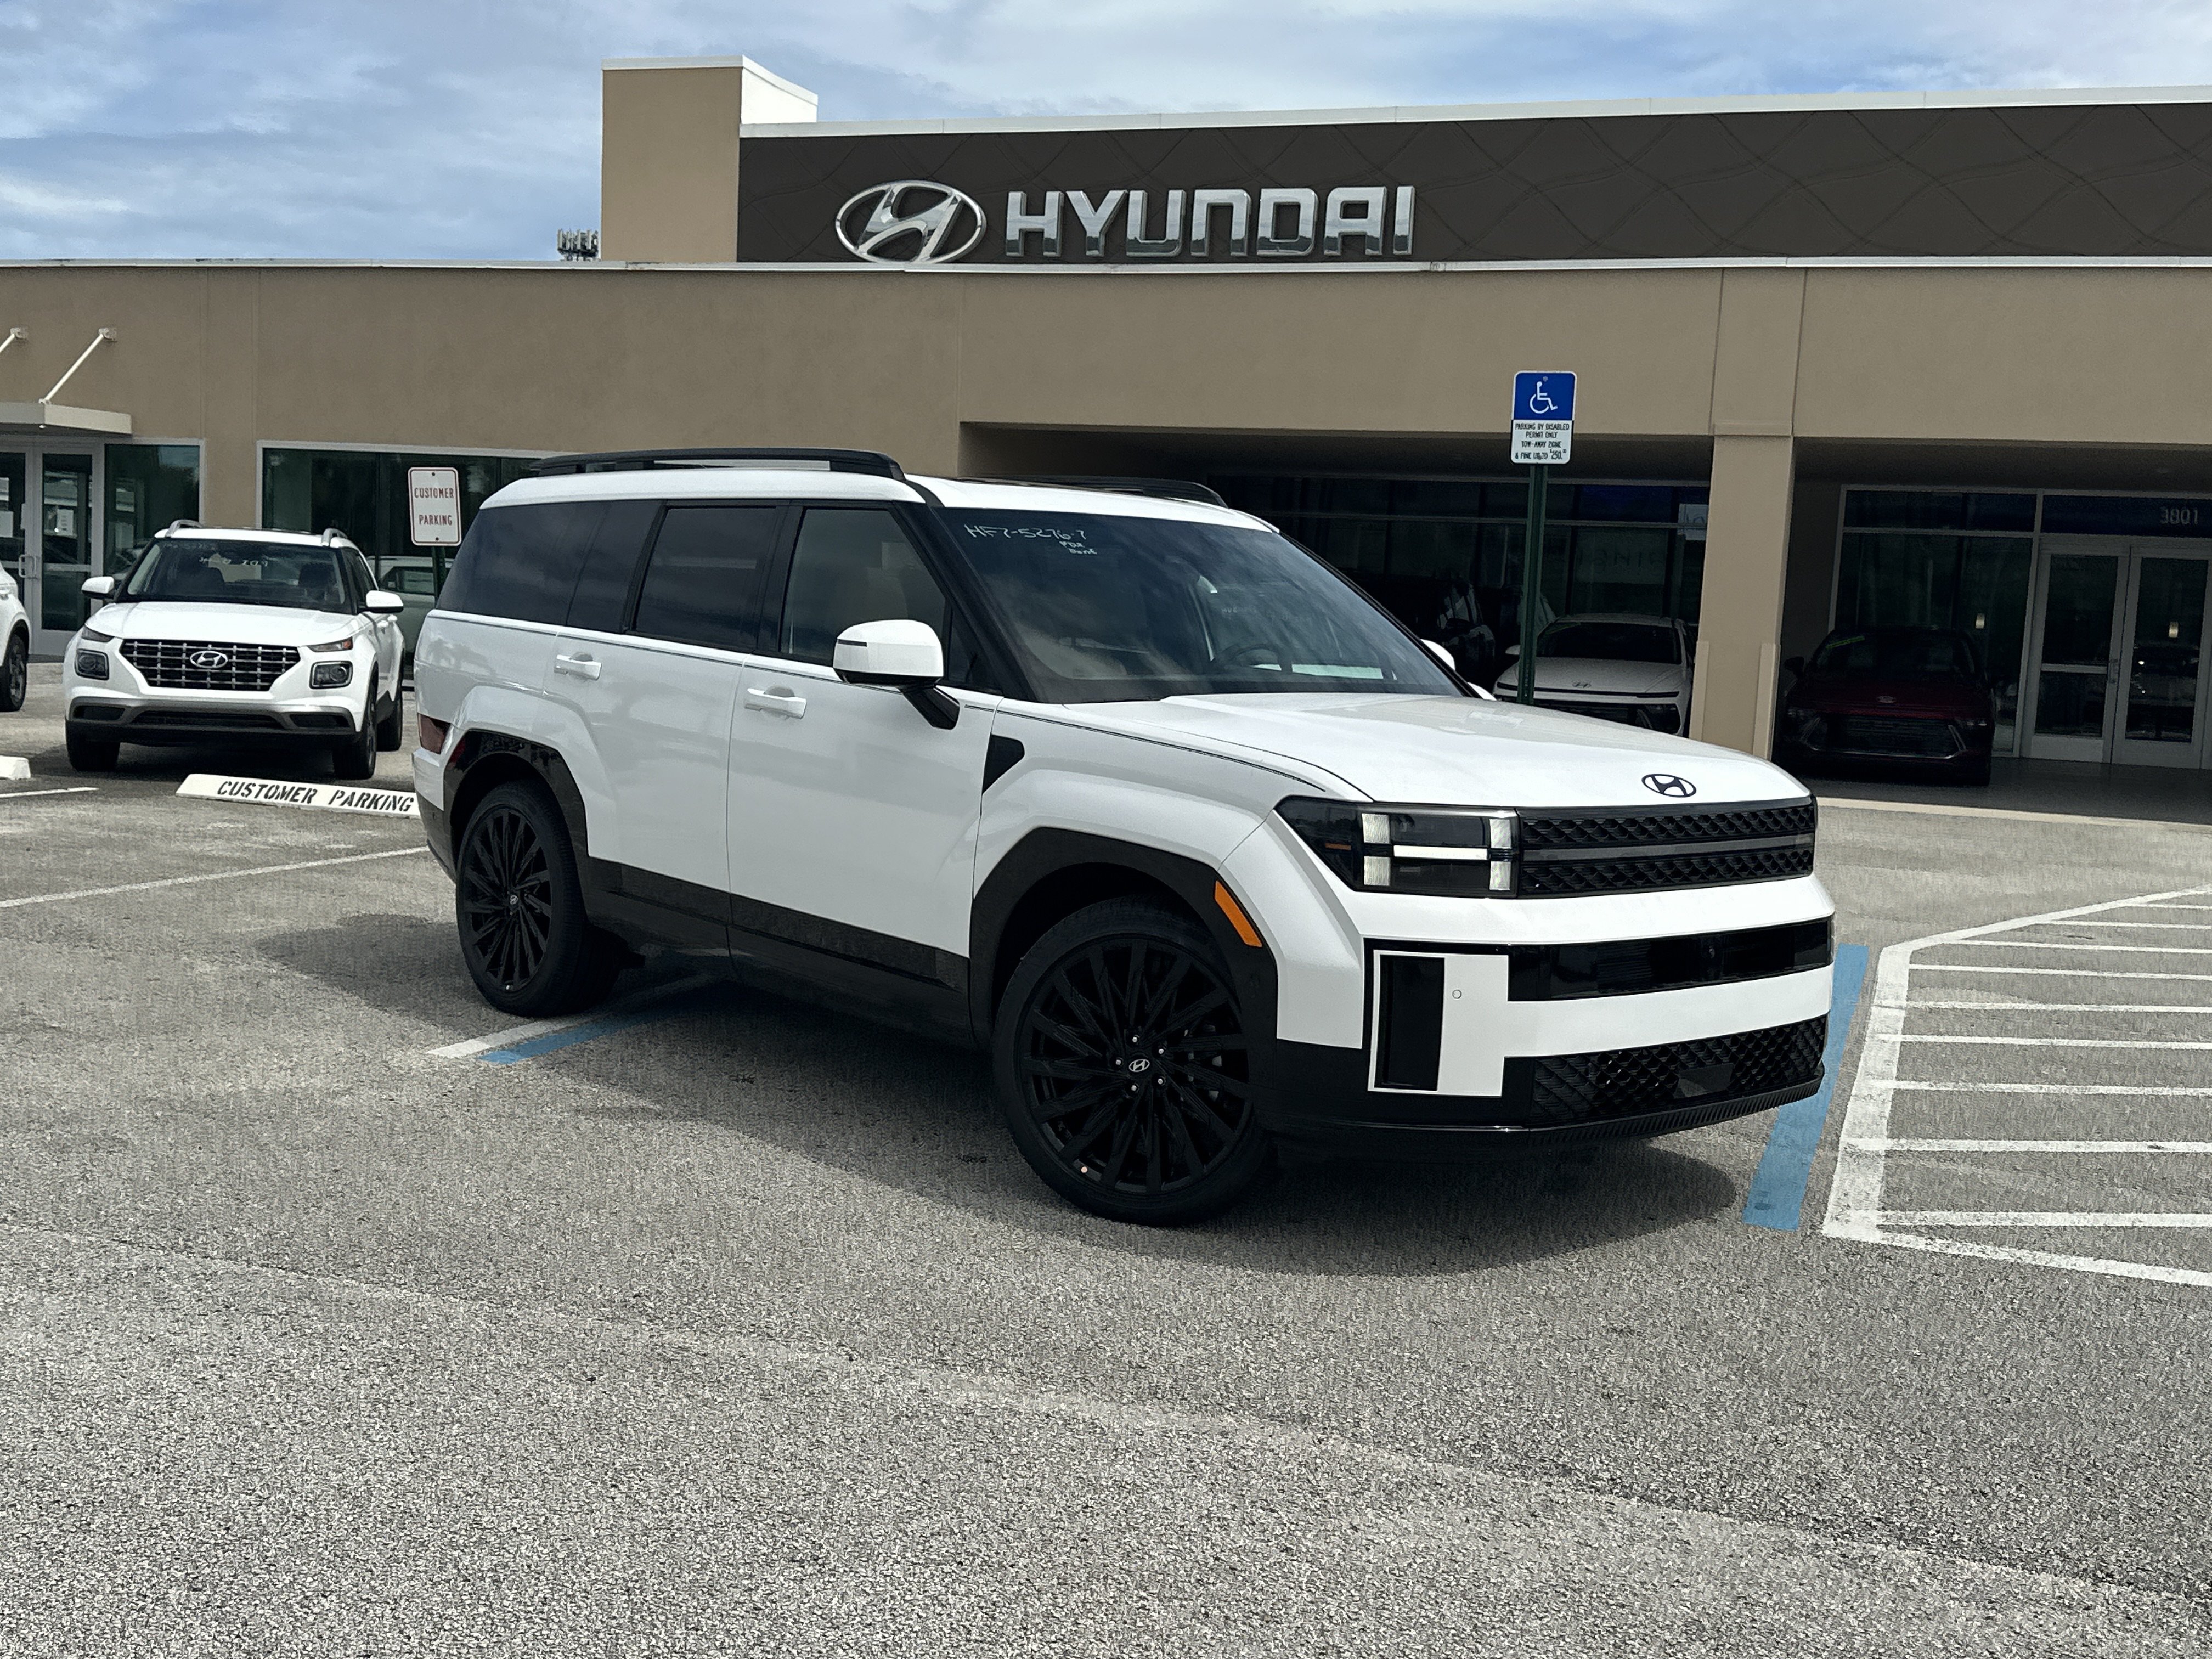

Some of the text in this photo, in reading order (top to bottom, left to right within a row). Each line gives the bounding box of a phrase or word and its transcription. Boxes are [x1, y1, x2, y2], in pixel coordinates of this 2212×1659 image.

[1006, 185, 1415, 257] HYUNDAI
[414, 487, 454, 499] CUSTOMER
[419, 514, 452, 526] PARKING
[217, 781, 414, 812] CUSTOMER PARKING
